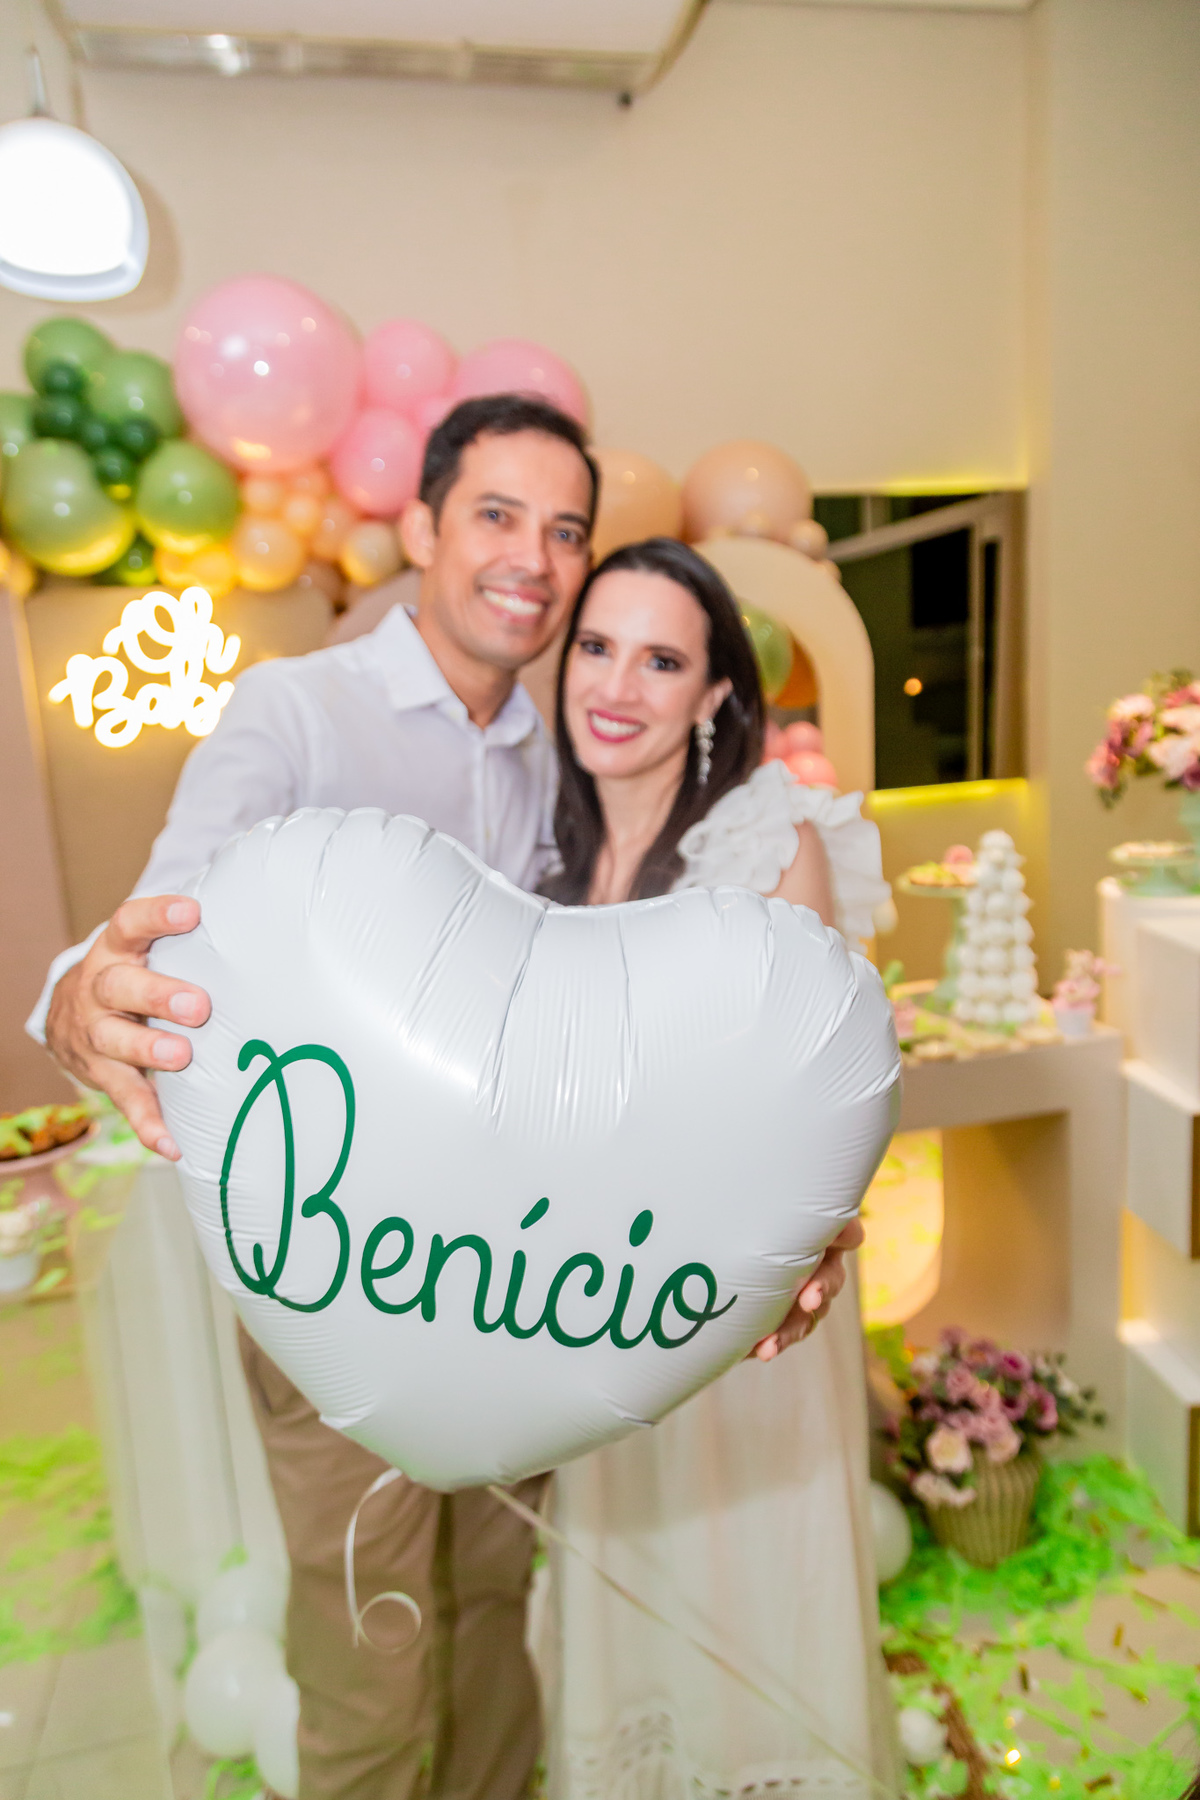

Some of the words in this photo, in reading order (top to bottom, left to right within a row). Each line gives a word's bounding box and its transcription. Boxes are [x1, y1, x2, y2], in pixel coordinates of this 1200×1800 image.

[102, 586, 241, 676] Oh
[48, 653, 235, 748] Bab
[219, 1038, 738, 1350] Benício
